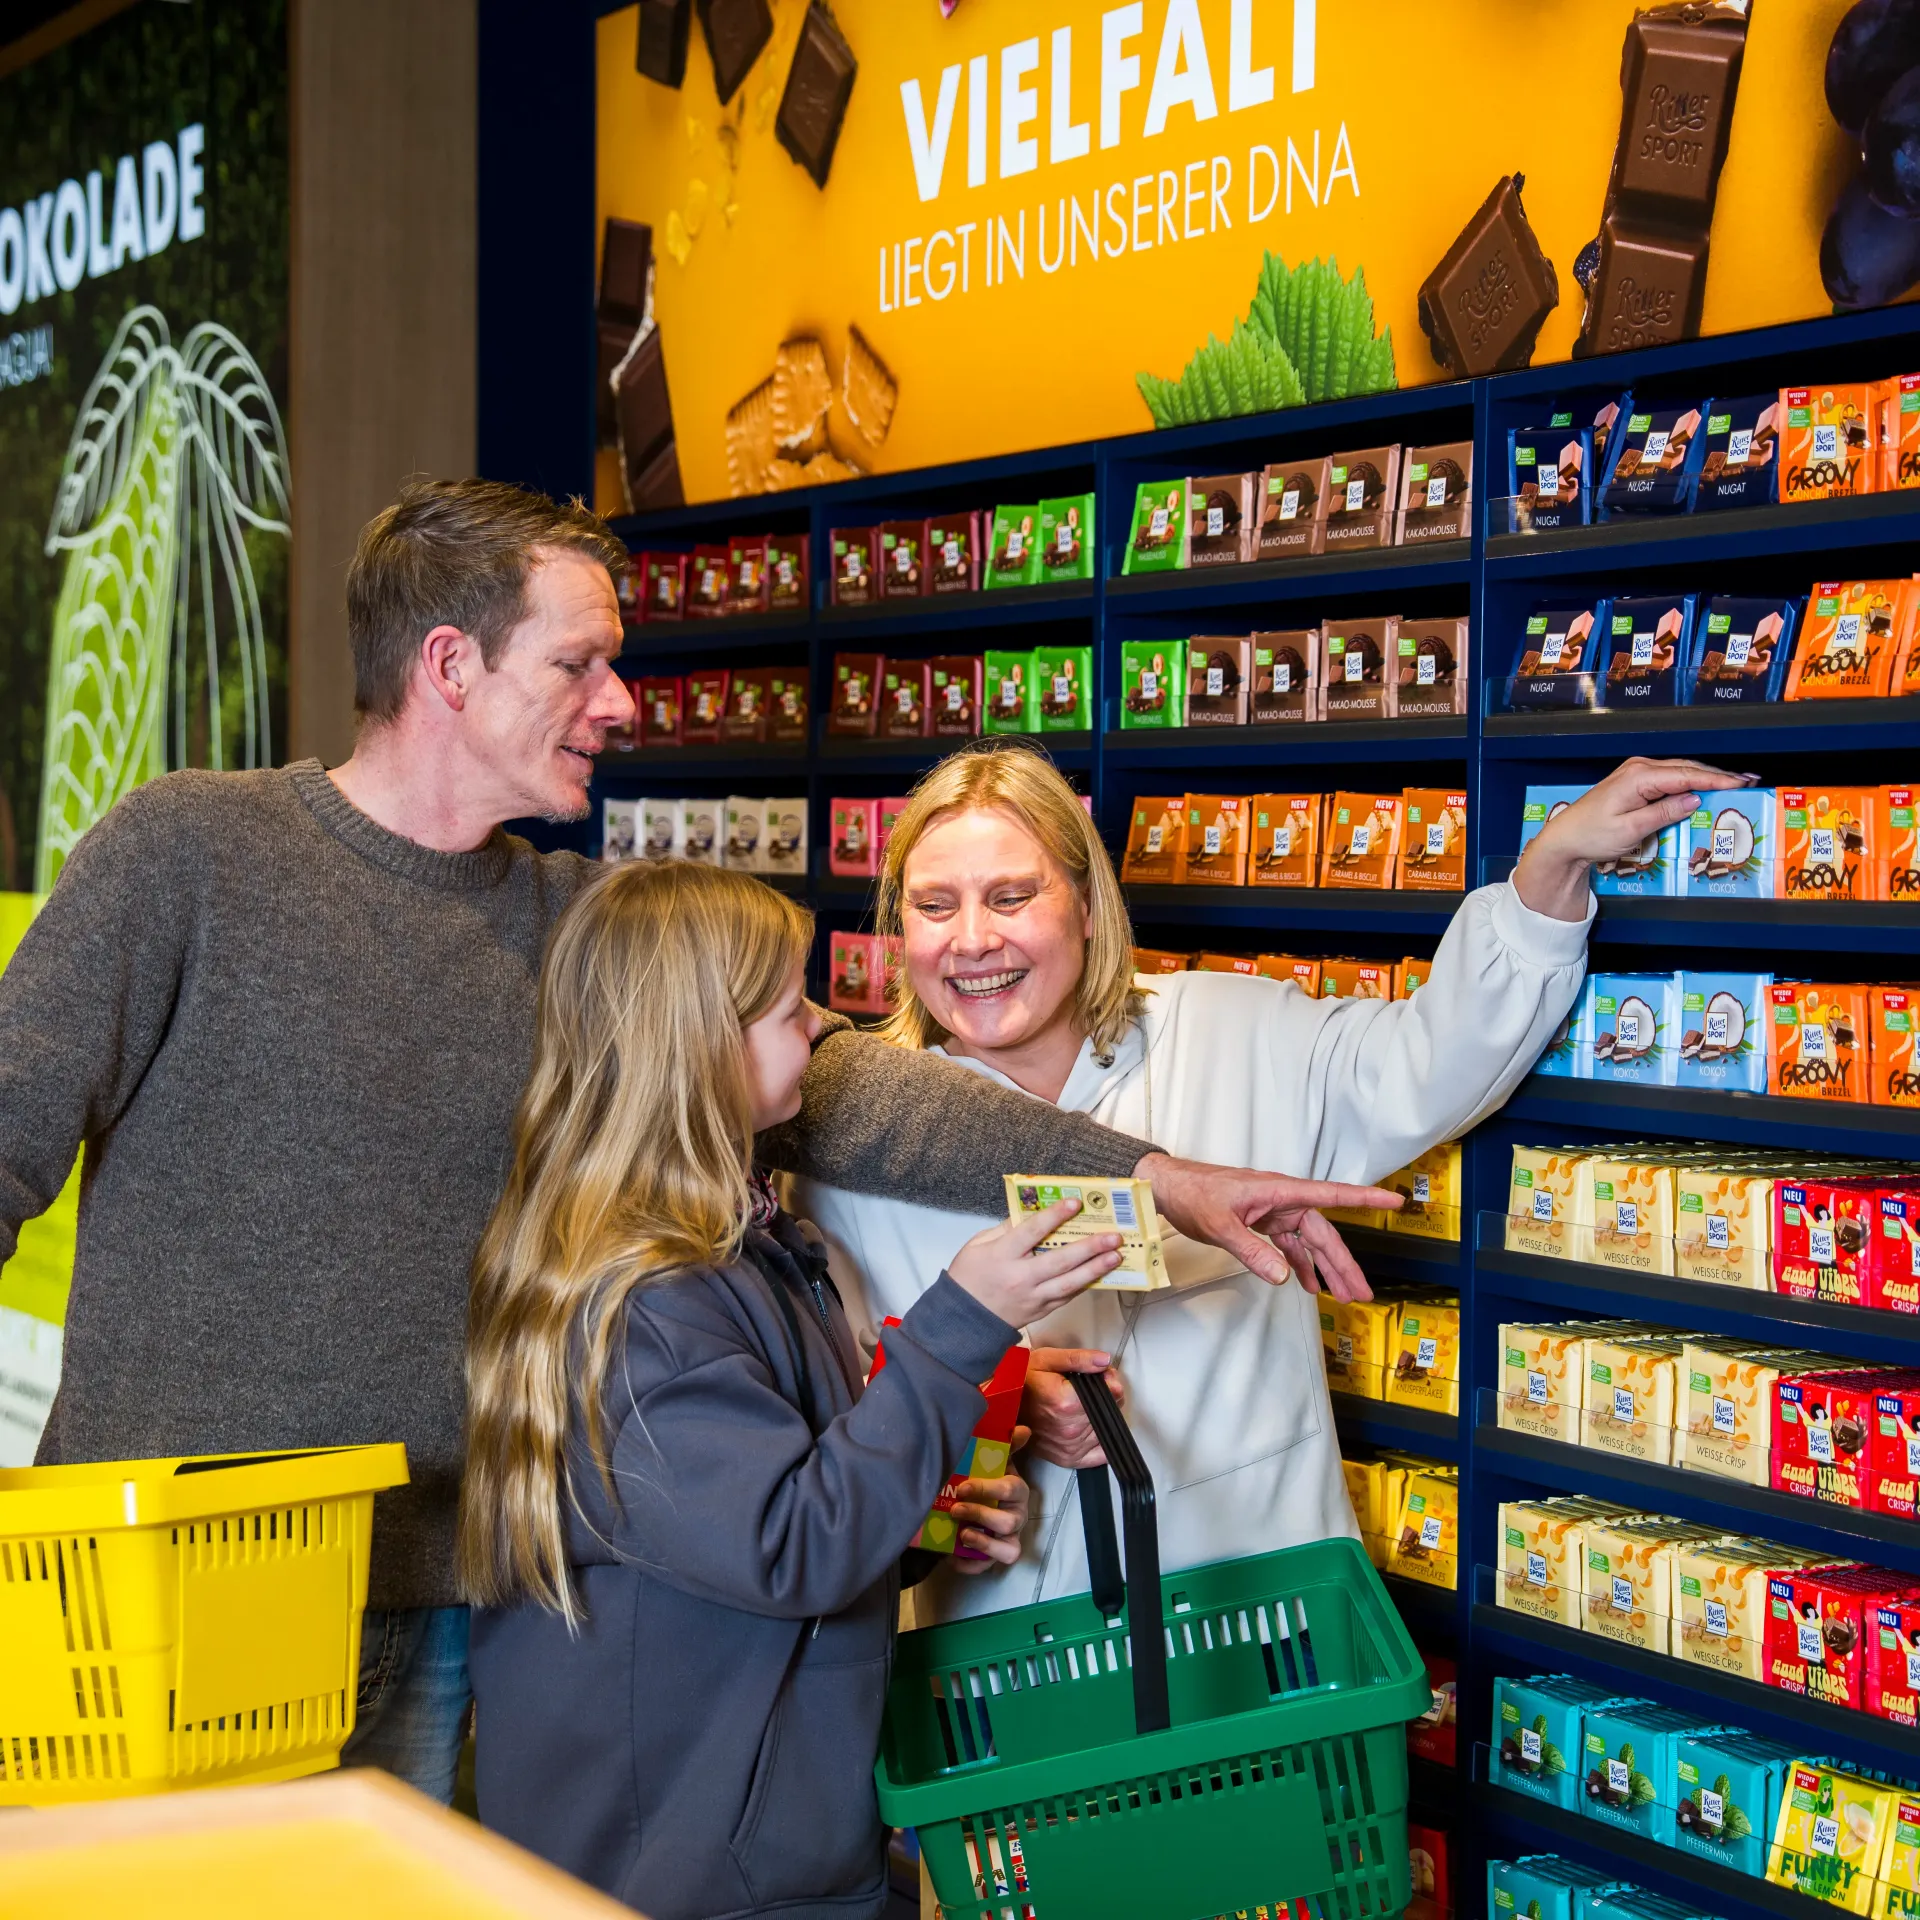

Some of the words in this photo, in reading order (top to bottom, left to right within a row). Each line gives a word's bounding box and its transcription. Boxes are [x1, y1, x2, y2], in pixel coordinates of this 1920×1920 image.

[1647, 84, 1709, 134] Ritter
[1640, 135, 1704, 168] SPORT
[879, 221, 975, 313] LIEGT
[984, 209, 1025, 285] IN
[1037, 155, 1233, 274] UNSERER
[1246, 121, 1360, 223] DNA
[1614, 277, 1676, 327] Ritter
[1471, 282, 1520, 354] SPORT
[1730, 448, 1748, 457] SPORT
[1815, 444, 1835, 452] SPORT
[1787, 458, 1860, 494] GROOVY
[1628, 481, 1655, 492] NUGAT
[1718, 483, 1746, 496] NUGAT
[1788, 489, 1827, 499] CRUNCHY
[1536, 516, 1560, 526] NUGAT
[1327, 525, 1374, 540] KAKAO-MOUSSE
[1405, 524, 1456, 538] KAKAO-MOUSSE
[1260, 533, 1306, 548] KAKAO-MOUSSE
[1836, 632, 1856, 641] SPORT
[1727, 652, 1747, 661] SPORT
[1801, 647, 1880, 680] GROOVY
[1840, 675, 1871, 685] BREZEL
[1530, 682, 1555, 693] NUGAT
[1625, 686, 1651, 696] NUGAT
[1714, 687, 1742, 699] NUGAT
[1328, 699, 1376, 709] KAKAO-MOUSSE
[1400, 703, 1450, 713] KAKAO-MOUSSE
[1257, 709, 1302, 720] KAKAO-MOUSSE
[1168, 801, 1184, 809] NEW
[1221, 801, 1237, 809] NEW
[1291, 800, 1308, 808] NEW
[1375, 800, 1394, 809] NEW
[1447, 796, 1466, 806] NEW
[1715, 847, 1733, 855] SPORT
[1813, 847, 1832, 855] SPORT
[1331, 870, 1354, 879] CARAMEL
[1359, 873, 1377, 881] BISCUIT
[1408, 870, 1432, 879] CARAMEL
[1438, 872, 1457, 881] BISCUIT
[1785, 863, 1858, 893] GROOVY
[1617, 882, 1643, 893] KOKOS
[1709, 883, 1736, 894] KOKOS
[1787, 890, 1826, 899] CRUNCHY
[1161, 958, 1177, 968] NEW
[1233, 961, 1251, 972] NEW
[1294, 964, 1311, 975] NEW
[1360, 968, 1378, 979] NEW
[1885, 994, 1905, 1002] WIEDER
[1620, 1033, 1637, 1041] SPORT
[1804, 1042, 1824, 1051] SPORT
[1613, 1068, 1639, 1079] KOKOS
[1699, 1066, 1726, 1077] KOKOS
[1779, 1058, 1852, 1089] GROOVY
[1781, 1085, 1819, 1096] CRUNCHY
[1822, 1086, 1851, 1097] BREZEL
[1783, 1190, 1802, 1203] NEU
[1882, 1201, 1902, 1214] NEU
[1396, 1217, 1443, 1233] KNUSPERFLAKES
[1618, 1219, 1635, 1228] SPORT
[1708, 1232, 1727, 1241] SPORT
[1518, 1236, 1542, 1250] WEISSE
[1543, 1243, 1562, 1256] CRISP
[1811, 1246, 1831, 1256] SPORT
[1604, 1252, 1629, 1265] WEISSE
[1631, 1256, 1650, 1267] CRISP
[1692, 1265, 1720, 1278] WEISSE
[1721, 1269, 1742, 1282] CRISP
[1789, 1285, 1816, 1299] CRISPY
[1818, 1290, 1850, 1304] CHOCO
[1891, 1299, 1920, 1314] CRISPY
[1396, 1384, 1443, 1399] KNUSPERFLAKES
[1530, 1388, 1545, 1397] SPORT
[1780, 1386, 1799, 1401] NEU
[1616, 1405, 1632, 1415] SPORT
[1879, 1399, 1898, 1413] NEU
[1514, 1416, 1539, 1433] WEISSE
[1540, 1425, 1558, 1437] CRISP
[1715, 1414, 1733, 1427] SPORT
[1598, 1434, 1624, 1450] WEISSE
[1626, 1443, 1645, 1457] CRISP
[1810, 1444, 1830, 1455] SPORT
[1696, 1445, 1723, 1463] WEISSE
[1725, 1454, 1746, 1469] CRISP
[1789, 1482, 1816, 1498] CRISPY
[1817, 1489, 1849, 1505] CHOCO
[1888, 1497, 1915, 1514] CRISPY
[1397, 1557, 1446, 1582] KNUSPERFLAKES
[1529, 1569, 1545, 1580] SPORT
[1771, 1582, 1789, 1597] NEU
[1614, 1594, 1631, 1605] SPORT
[1513, 1596, 1538, 1614] WEISSE
[1539, 1605, 1558, 1620] CRISP
[1707, 1617, 1725, 1629] SPORT
[1878, 1610, 1897, 1626] NEU
[1598, 1623, 1624, 1640] WEISSE
[1626, 1632, 1645, 1647] CRISP
[1800, 1642, 1819, 1655] SPORT
[1692, 1649, 1720, 1665] WEISSE
[1722, 1657, 1743, 1672] CRISP
[1780, 1678, 1806, 1695] CRISPY
[1889, 1710, 1917, 1727] CRISPY
[1523, 1745, 1539, 1757] SPORT
[1611, 1777, 1627, 1787] SPORT
[1797, 1772, 1816, 1783] WIEDER
[1508, 1772, 1550, 1799] PFEFFERMINZ
[1703, 1794, 1721, 1810] Ritter
[1703, 1807, 1721, 1820] SPORT
[1900, 1805, 1920, 1816] WIEDER
[1596, 1805, 1640, 1830] PFEFFERMINZ
[1816, 1821, 1836, 1838] Ritter
[1814, 1834, 1834, 1848] SPORT
[1687, 1836, 1734, 1864] PFEFFERMINZ
[1780, 1851, 1861, 1889] FUNKY
[1788, 1871, 1811, 1889] WHITE
[1813, 1881, 1846, 1901] LEMON
